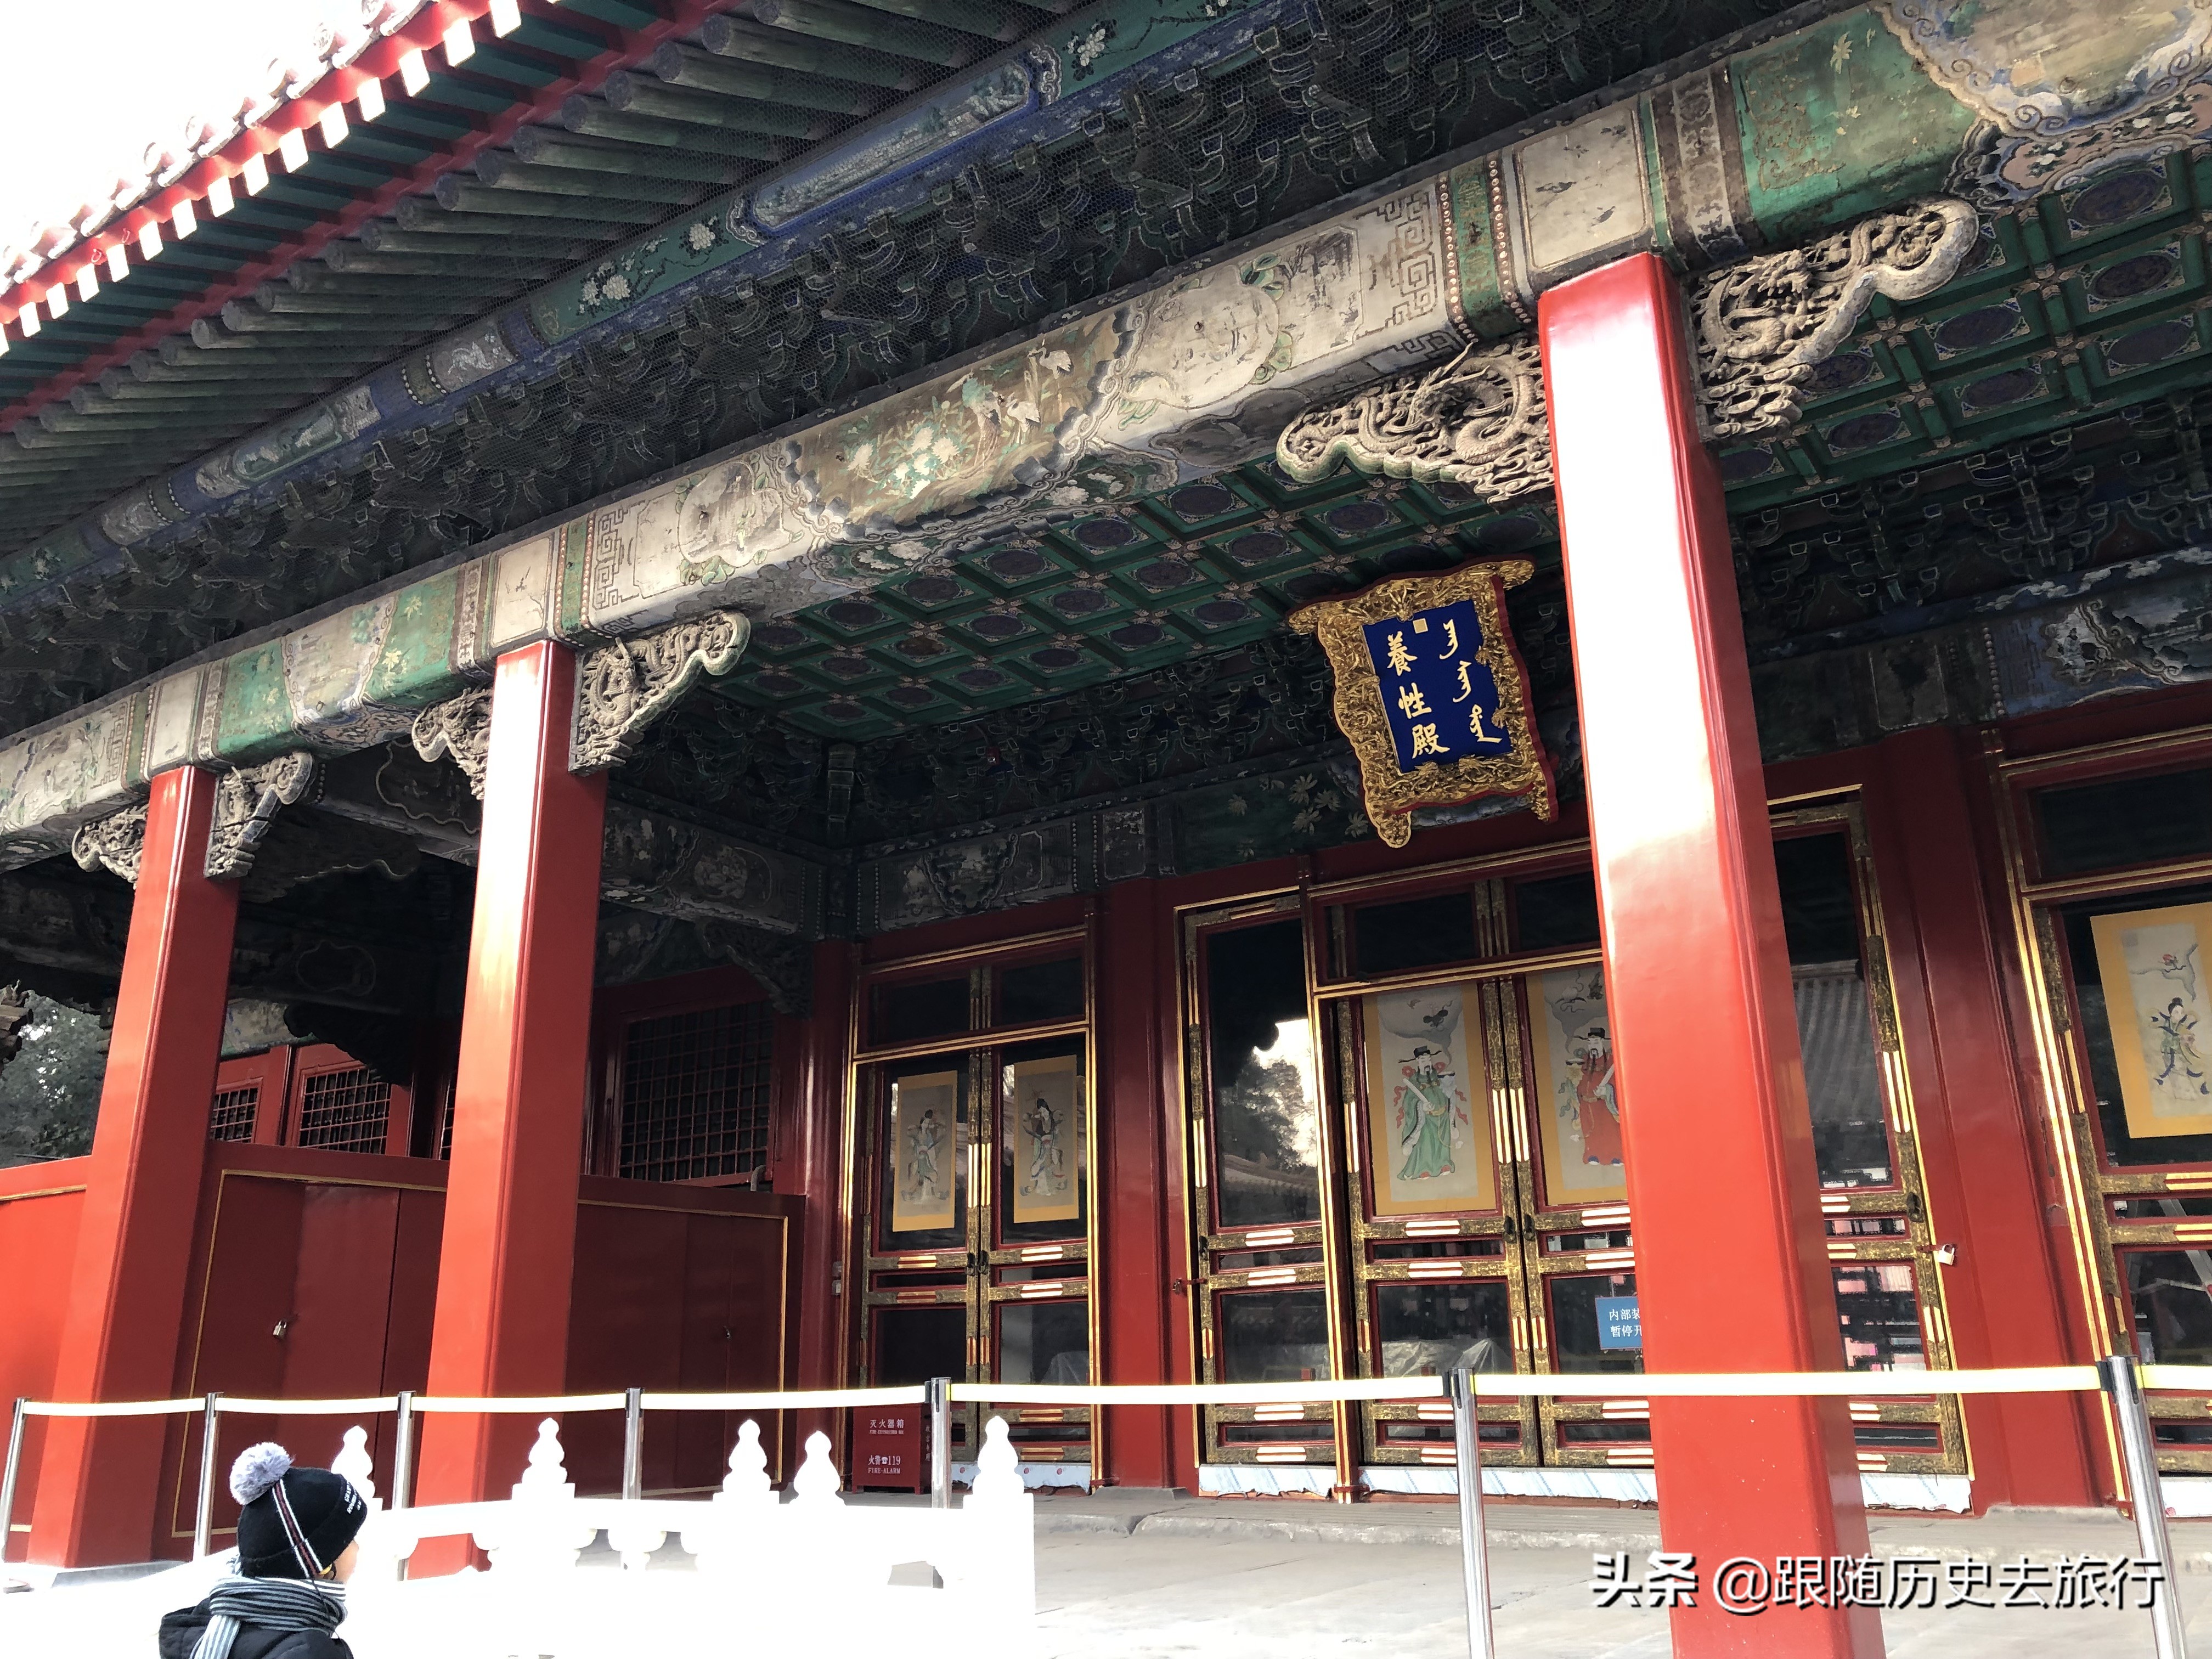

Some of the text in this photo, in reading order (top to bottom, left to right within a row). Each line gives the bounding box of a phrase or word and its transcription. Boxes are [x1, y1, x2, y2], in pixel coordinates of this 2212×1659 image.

[1387, 630, 1451, 759] 養性殿
[1610, 1325, 1643, 1338] 暂停开
[870, 1419, 904, 1429] 灭火器箱
